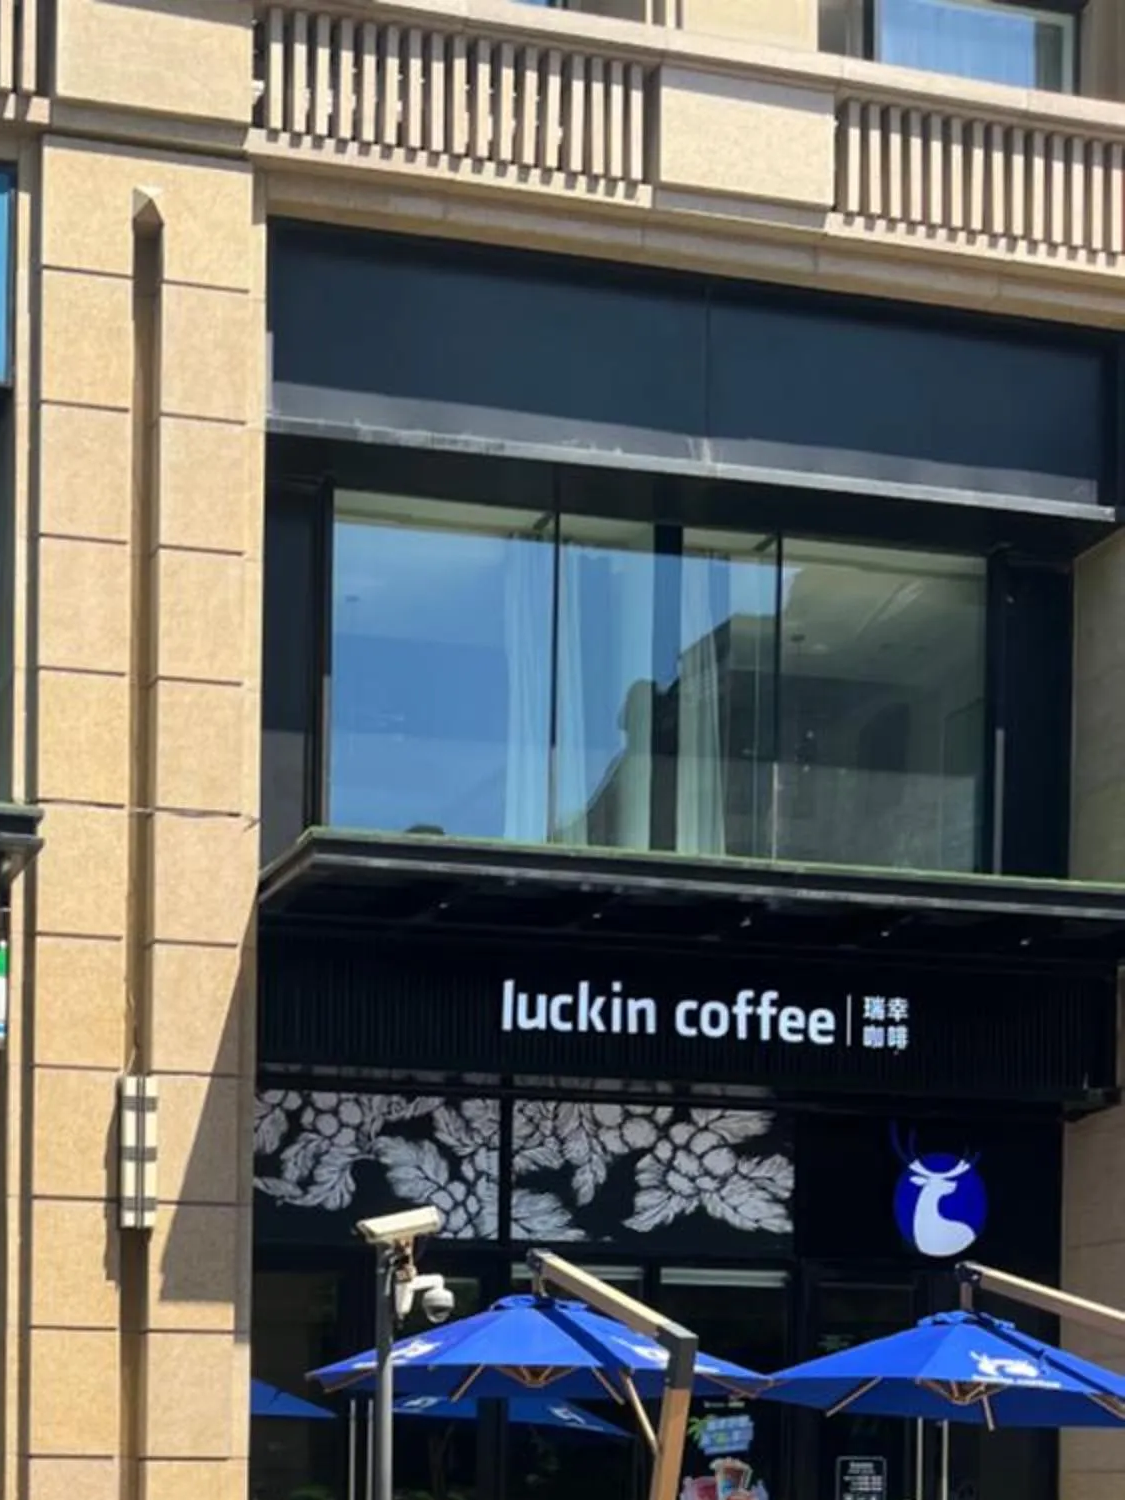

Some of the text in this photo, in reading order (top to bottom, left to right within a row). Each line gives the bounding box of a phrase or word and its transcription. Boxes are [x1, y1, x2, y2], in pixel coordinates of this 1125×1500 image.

[501, 979, 836, 1044] luckin coffee
[862, 996, 909, 1022] 瑞幸
